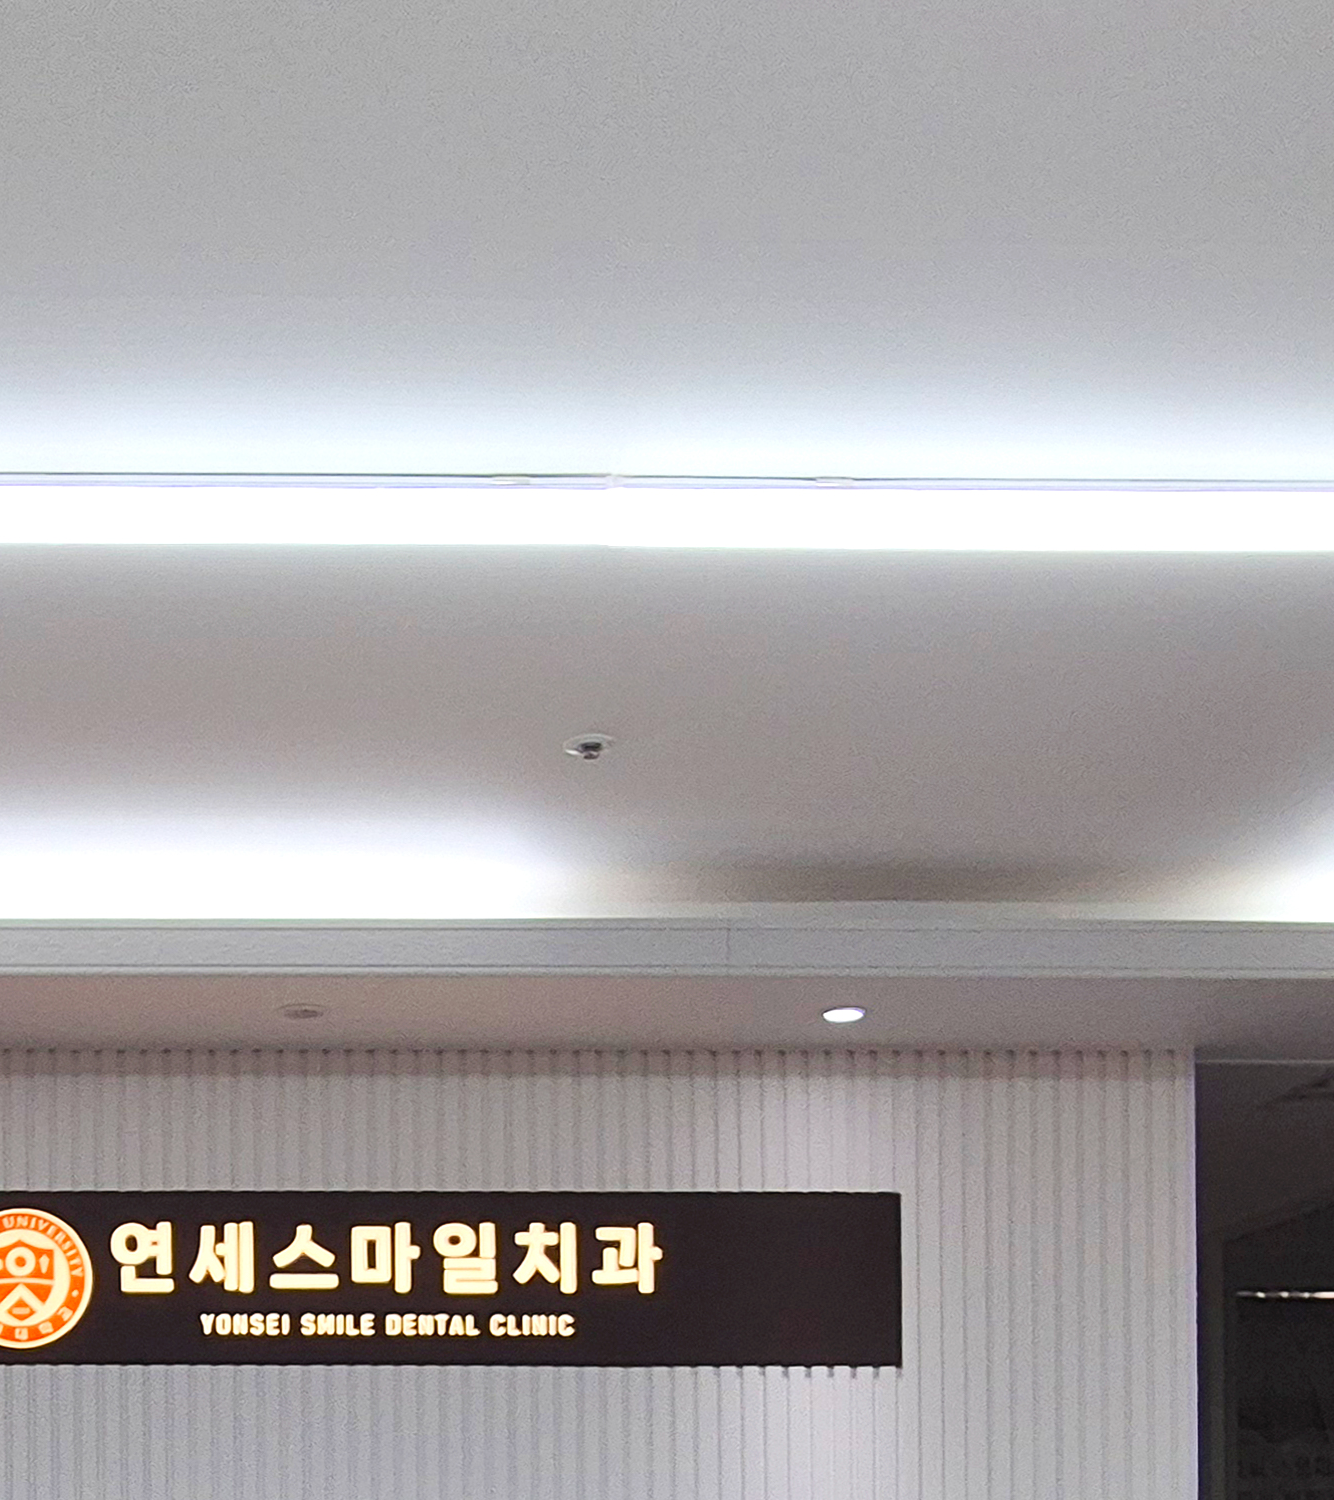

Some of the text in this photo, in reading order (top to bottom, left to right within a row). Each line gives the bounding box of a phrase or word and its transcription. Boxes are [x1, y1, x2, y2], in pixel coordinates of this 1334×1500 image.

[2, 1215, 83, 1277] UNIVERSITY
[110, 1221, 664, 1295] 연세스마일치과
[200, 1312, 575, 1337] YONSEI SMILE DENTAL CLINIC
